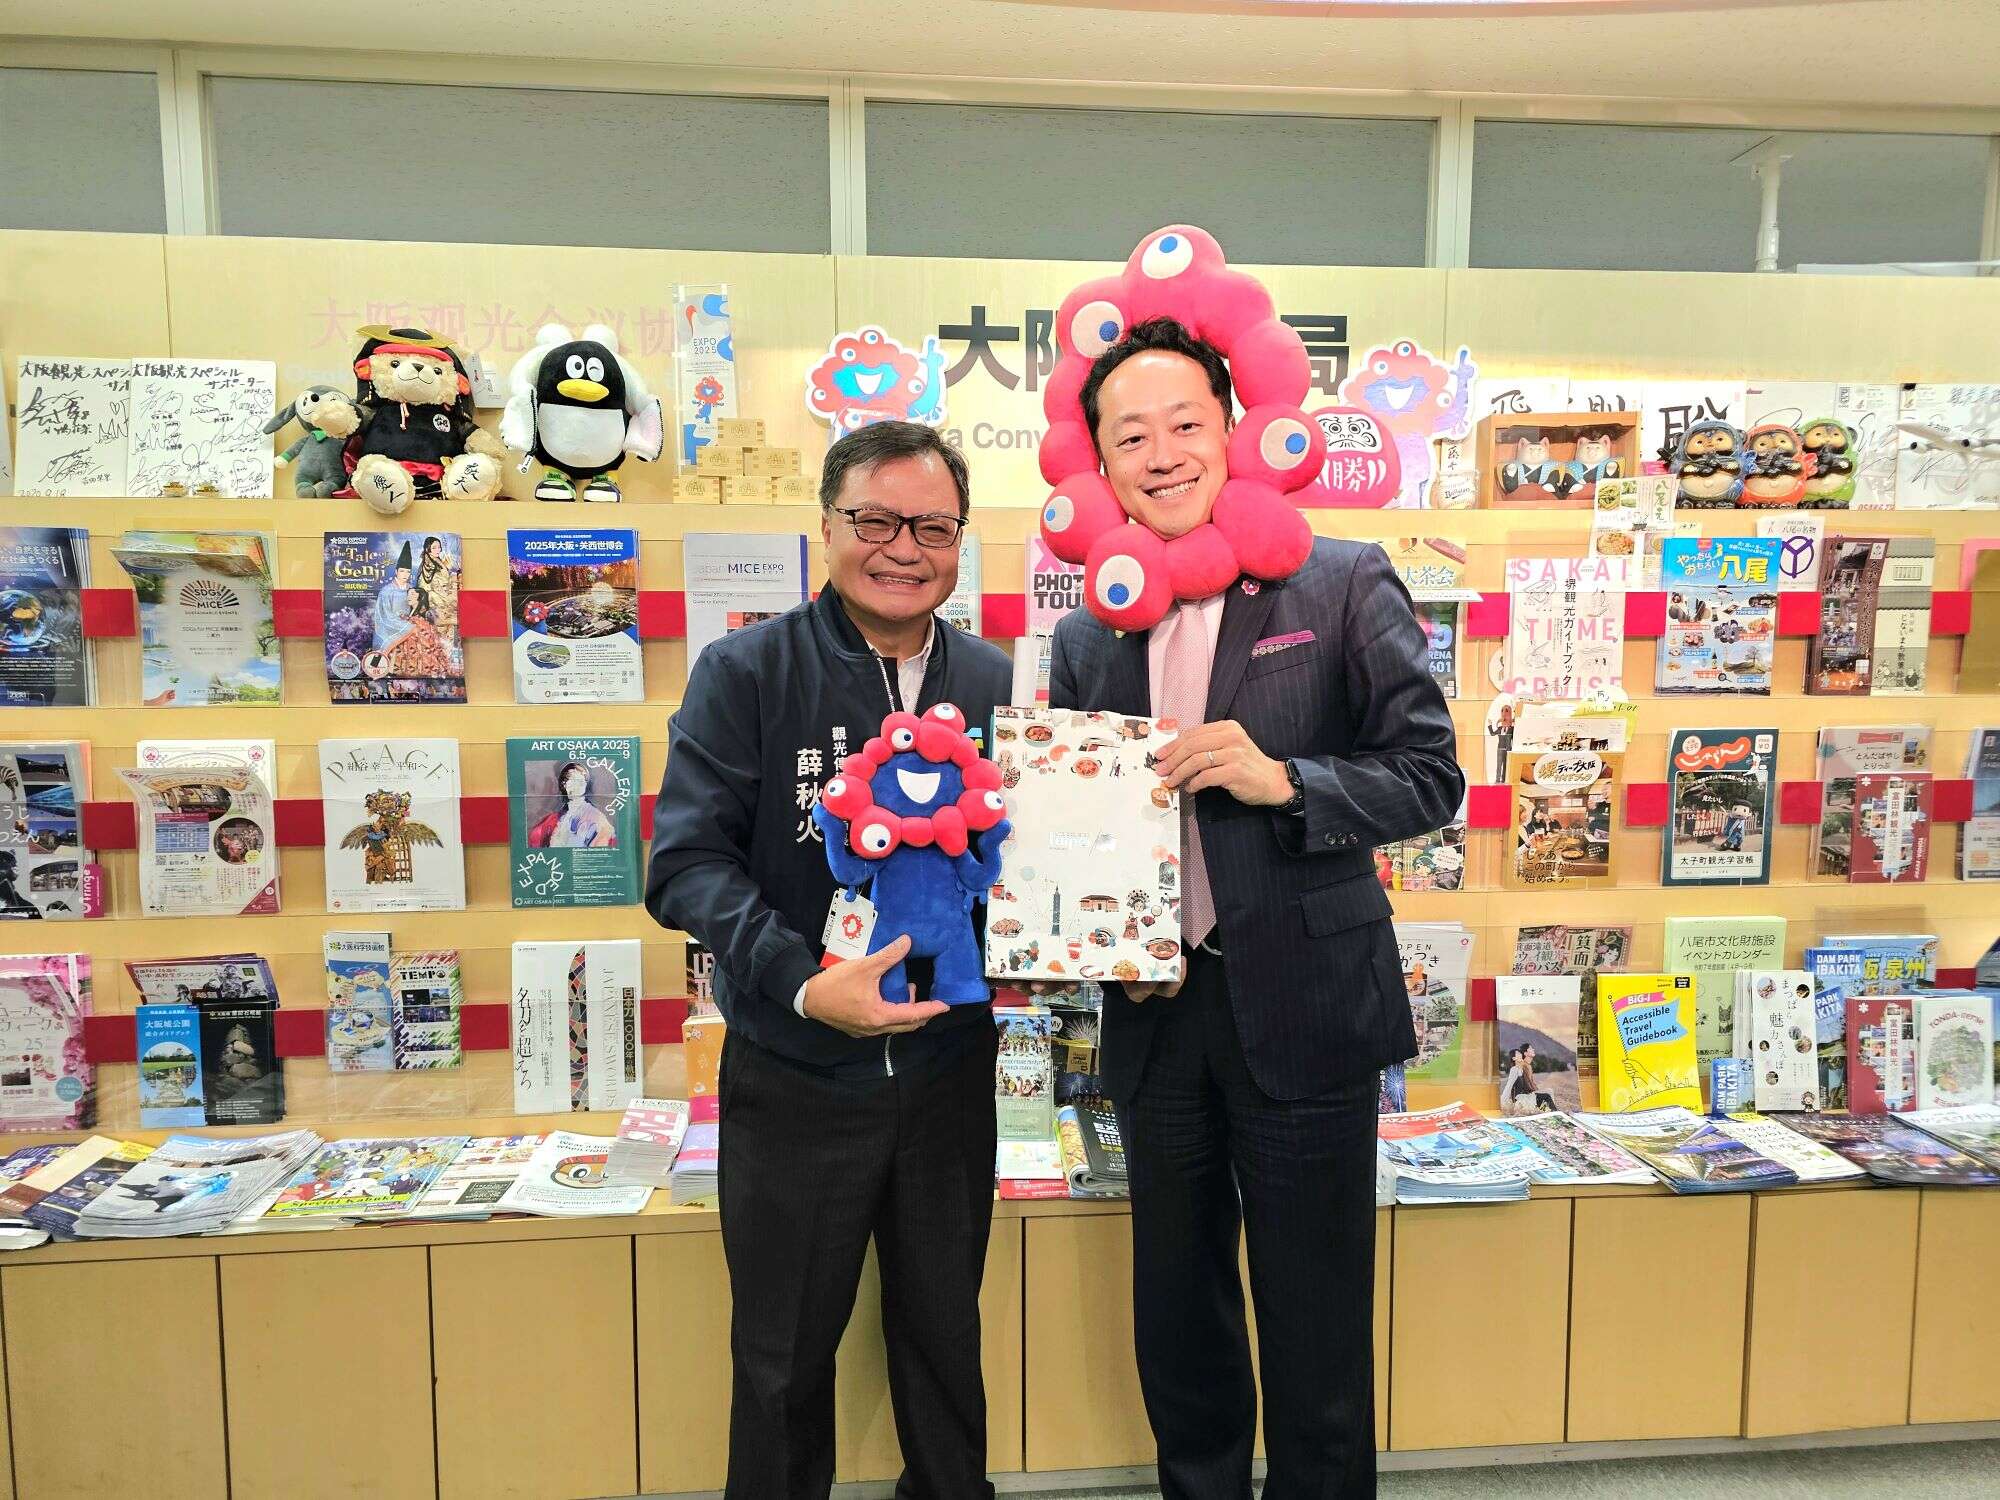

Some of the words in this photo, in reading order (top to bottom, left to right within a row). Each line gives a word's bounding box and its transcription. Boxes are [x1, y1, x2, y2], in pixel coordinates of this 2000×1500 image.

[693, 337, 717, 346] EXPO
[694, 346, 718, 355] 2025
[1332, 456, 1367, 493] 勝
[335, 560, 385, 582] Genji
[728, 563, 760, 574] MICE
[762, 563, 784, 571] EXPO
[1396, 565, 1456, 586] 大茶会
[1516, 559, 1628, 581] SAKAI
[1718, 554, 1769, 583] 八尾
[194, 588, 223, 597] SDGs
[1033, 591, 1086, 610] TOU
[197, 601, 223, 609] MICE
[1526, 618, 1617, 641] TIME
[1563, 578, 1577, 686] 堺観光ガイドブック
[1428, 662, 1452, 673] 601
[531, 740, 555, 751] ART
[557, 740, 600, 751] OSAKA
[602, 740, 630, 750] 2025
[568, 750, 587, 760] 6.5
[622, 750, 630, 760] 9
[831, 726, 848, 777] 觀光傳
[1680, 744, 1744, 766] じゃらん
[1856, 752, 1900, 761] とんだばやし
[1557, 760, 1596, 774] ディープ大阪
[586, 757, 631, 816] GALLERIES
[796, 748, 824, 843] 薛秋火
[1680, 855, 1754, 866] 太子町観光学習帳
[517, 851, 564, 895] EXPANDED
[1680, 934, 1776, 947] 八尾市文化財施設
[1573, 935, 1589, 967] 箕面
[1682, 949, 1771, 961] イベントカレンダー
[1816, 954, 1836, 964] DAM
[1837, 954, 1861, 963] PARK
[1816, 964, 1860, 977] IBAKITA
[1883, 957, 1926, 980] 泉州
[1815, 992, 1841, 1007] PARK
[145, 1020, 191, 1029] 大阪城公園
[1621, 1006, 1671, 1026] Accessible
[1624, 1021, 1652, 1038] Travel
[1627, 1026, 1678, 1047] Guidebook
[1715, 1064, 1726, 1087] PARK
[1724, 1064, 1738, 1109] IBAKITA
[1716, 1088, 1726, 1110] DAM
[290, 1199, 341, 1208] Special
[345, 1195, 396, 1203] Kabuki
